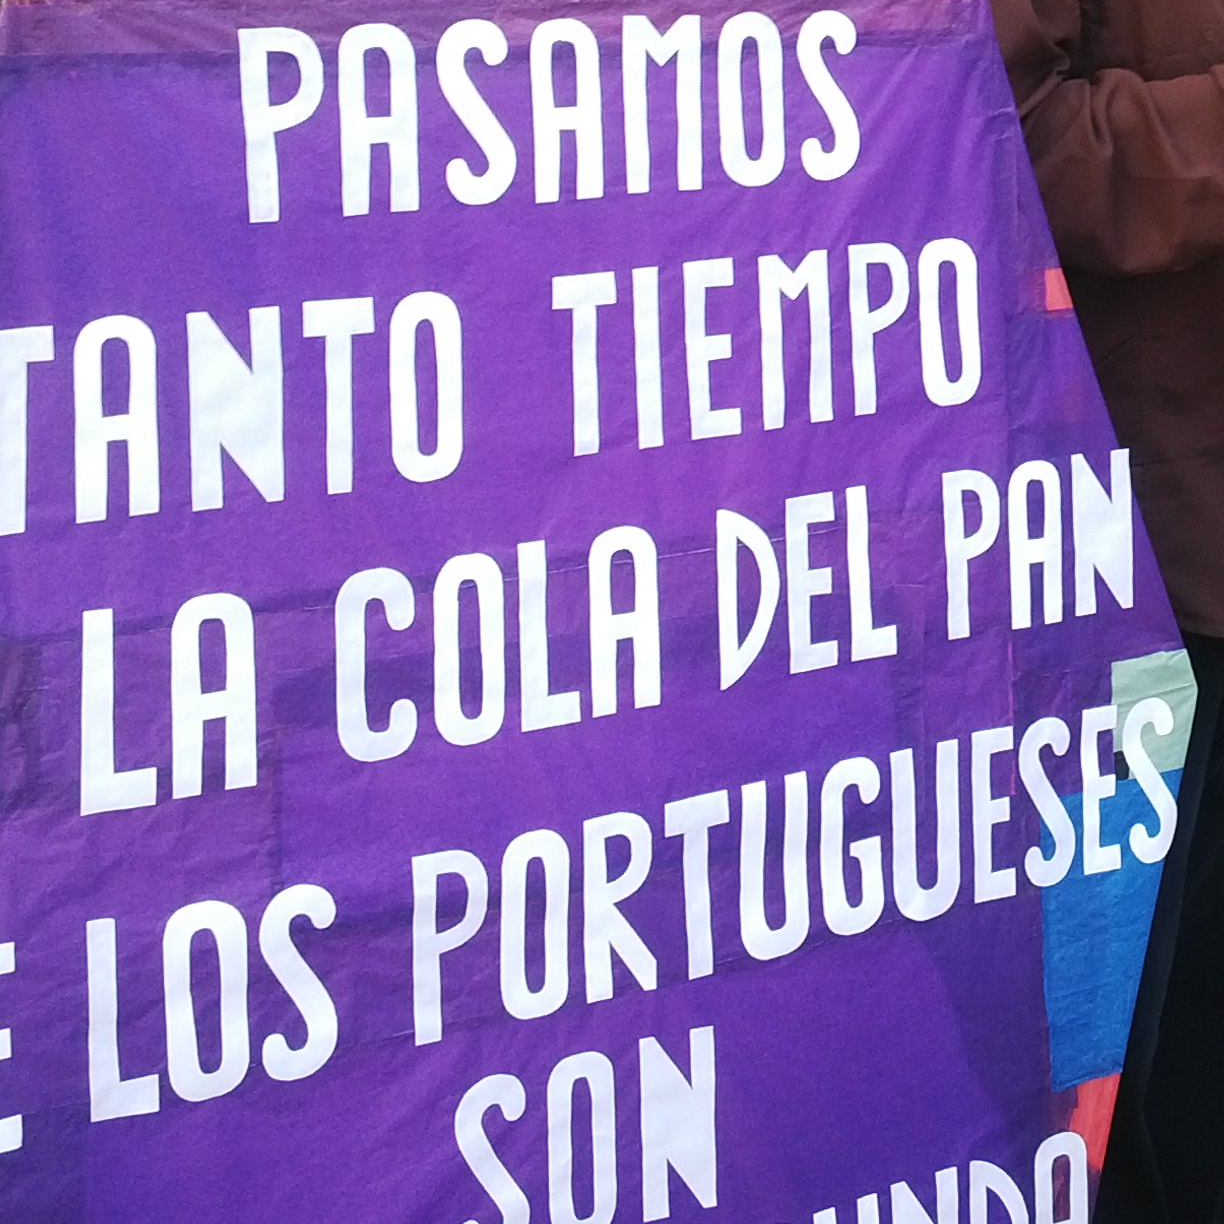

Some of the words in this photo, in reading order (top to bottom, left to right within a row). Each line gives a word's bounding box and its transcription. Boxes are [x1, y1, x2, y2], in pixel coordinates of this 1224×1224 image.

[238, 10, 861, 224] PASAMOS
[0, 291, 464, 537] TANTO
[552, 238, 982, 457] TIEMPO
[80, 592, 258, 817] LA
[335, 525, 662, 762] COLA
[716, 484, 898, 690] DEL
[942, 448, 1134, 641] PAN
[86, 884, 339, 1123] LOS
[411, 697, 1178, 1047] PORTUGUESES
[454, 1025, 719, 1224] SON
